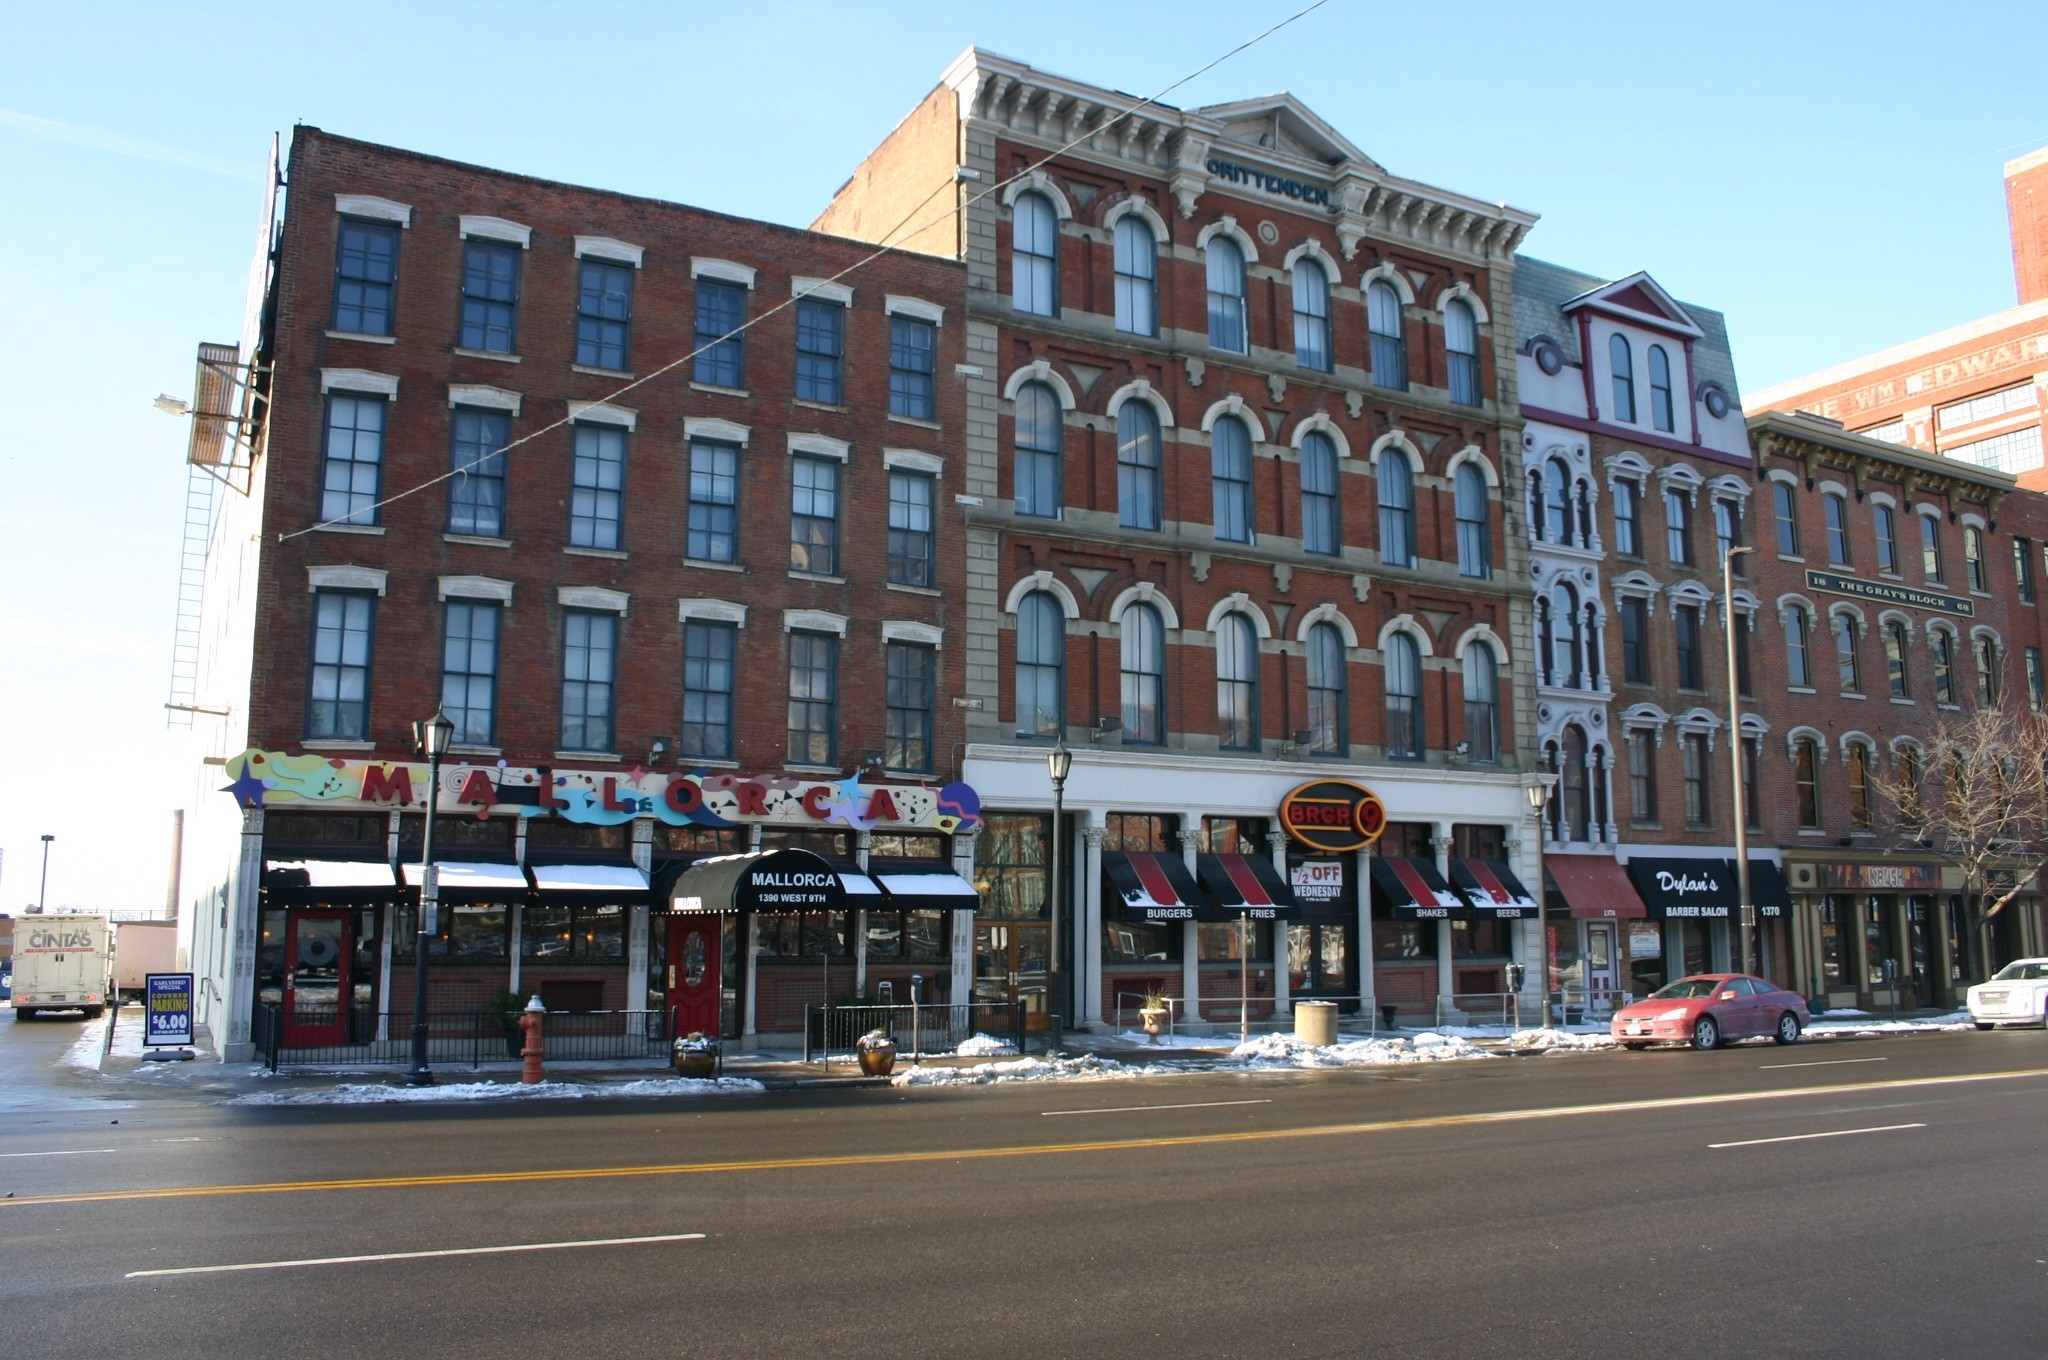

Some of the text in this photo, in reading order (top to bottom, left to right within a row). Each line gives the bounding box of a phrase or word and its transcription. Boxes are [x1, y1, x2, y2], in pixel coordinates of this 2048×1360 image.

[1207, 159, 1328, 206] CRITTENDEN
[1813, 577, 1969, 611] 18 THE GRAY'S BLOCK 68
[360, 766, 900, 820] MALLORCA
[1291, 802, 1379, 831] BRGR 9
[1312, 866, 1340, 880] OFF
[752, 873, 836, 887] MALLORCA
[1656, 871, 1718, 896] Dylan's
[758, 894, 779, 902] 1390
[781, 894, 807, 902] WEST
[1294, 886, 1341, 897] WEDNESDAY
[1147, 909, 1193, 918] BURGERS
[1250, 909, 1276, 918] FRIES
[1416, 908, 1448, 917] SHAKES
[1496, 909, 1521, 917] BEERS
[1666, 907, 1728, 916] BARBER SALON
[1761, 907, 1780, 916] 1370
[29, 930, 92, 948] CINTAS
[151, 999, 188, 1012] PARKING
[153, 1014, 187, 1030] $6.00
